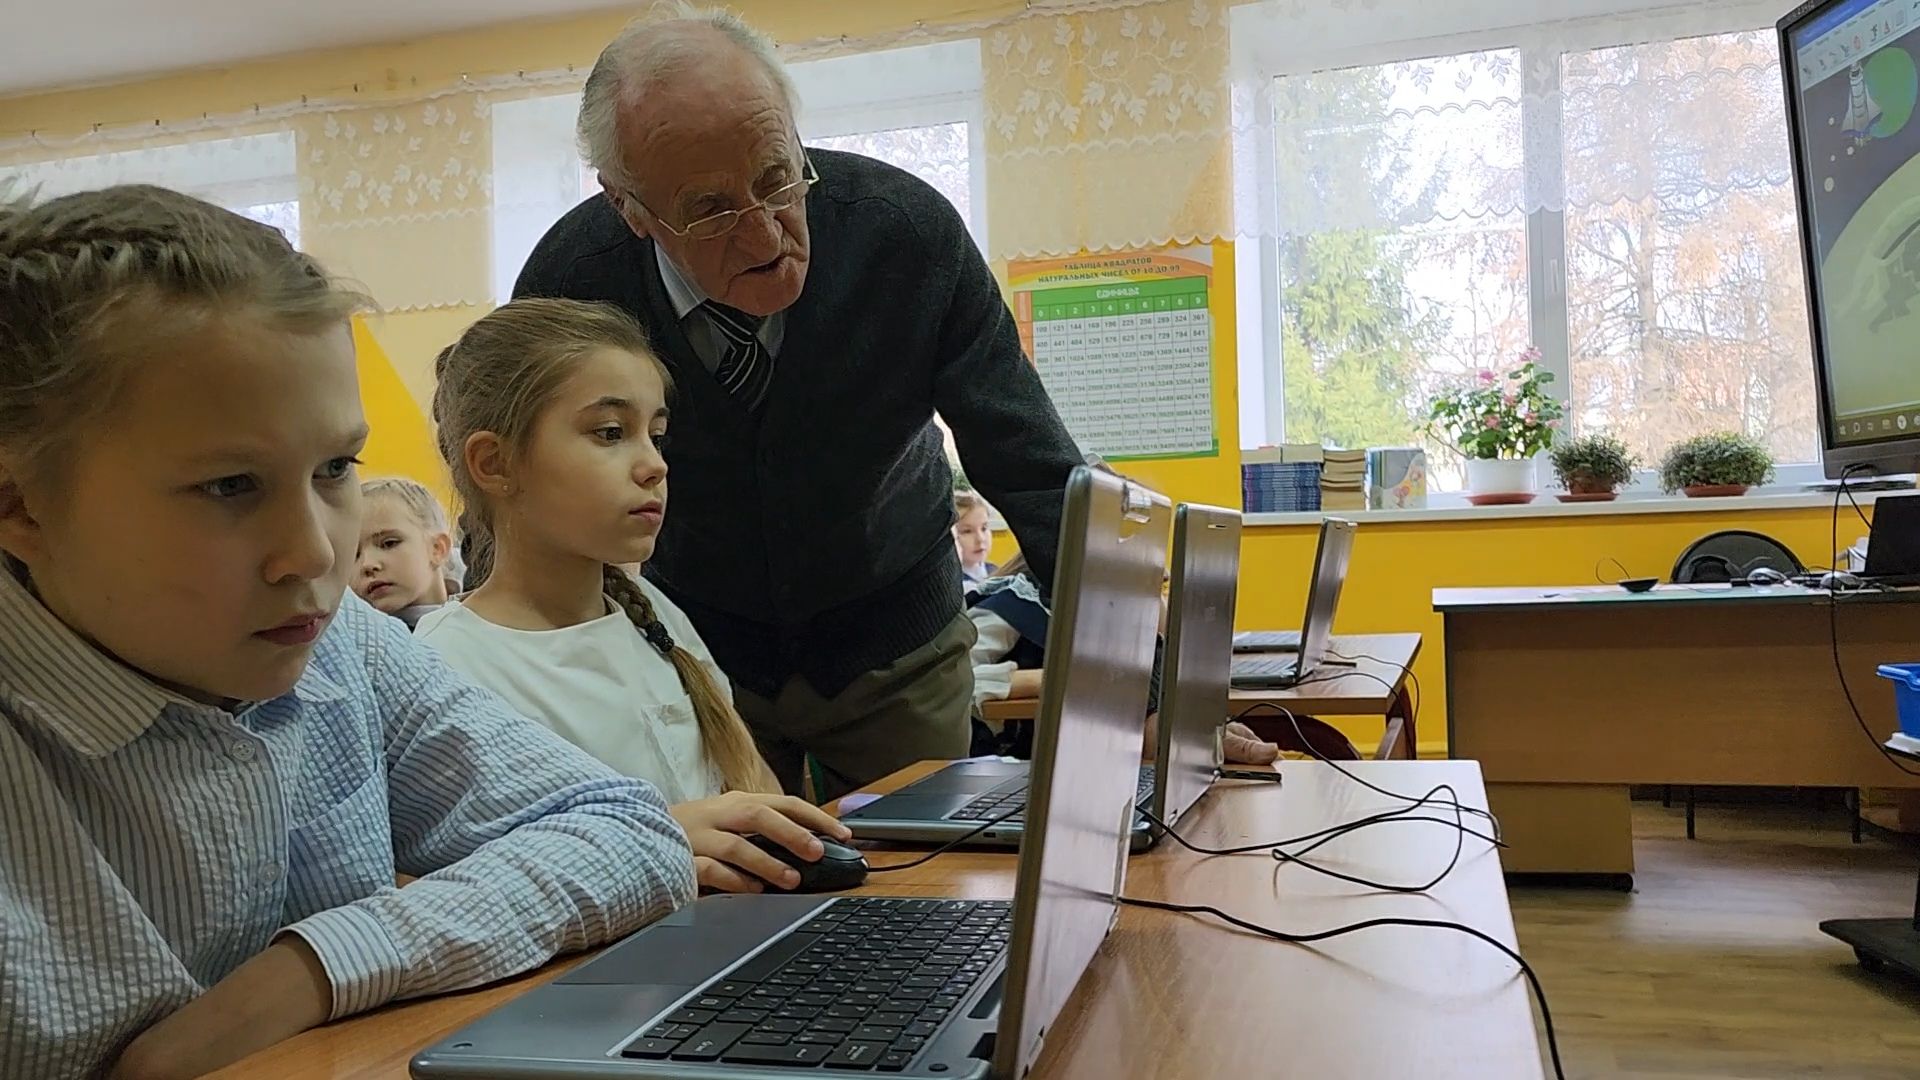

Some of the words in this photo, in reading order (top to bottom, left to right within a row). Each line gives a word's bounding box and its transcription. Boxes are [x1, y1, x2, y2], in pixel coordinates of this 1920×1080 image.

[1065, 262, 1101, 271] ТАБЛИЦА
[1104, 257, 1152, 267] КВАДРАТОВ
[1038, 272, 1098, 283] НАТУРАЛЬНЫХ
[1101, 270, 1129, 278] ЧИСЕЛ
[1155, 266, 1168, 275] ДО
